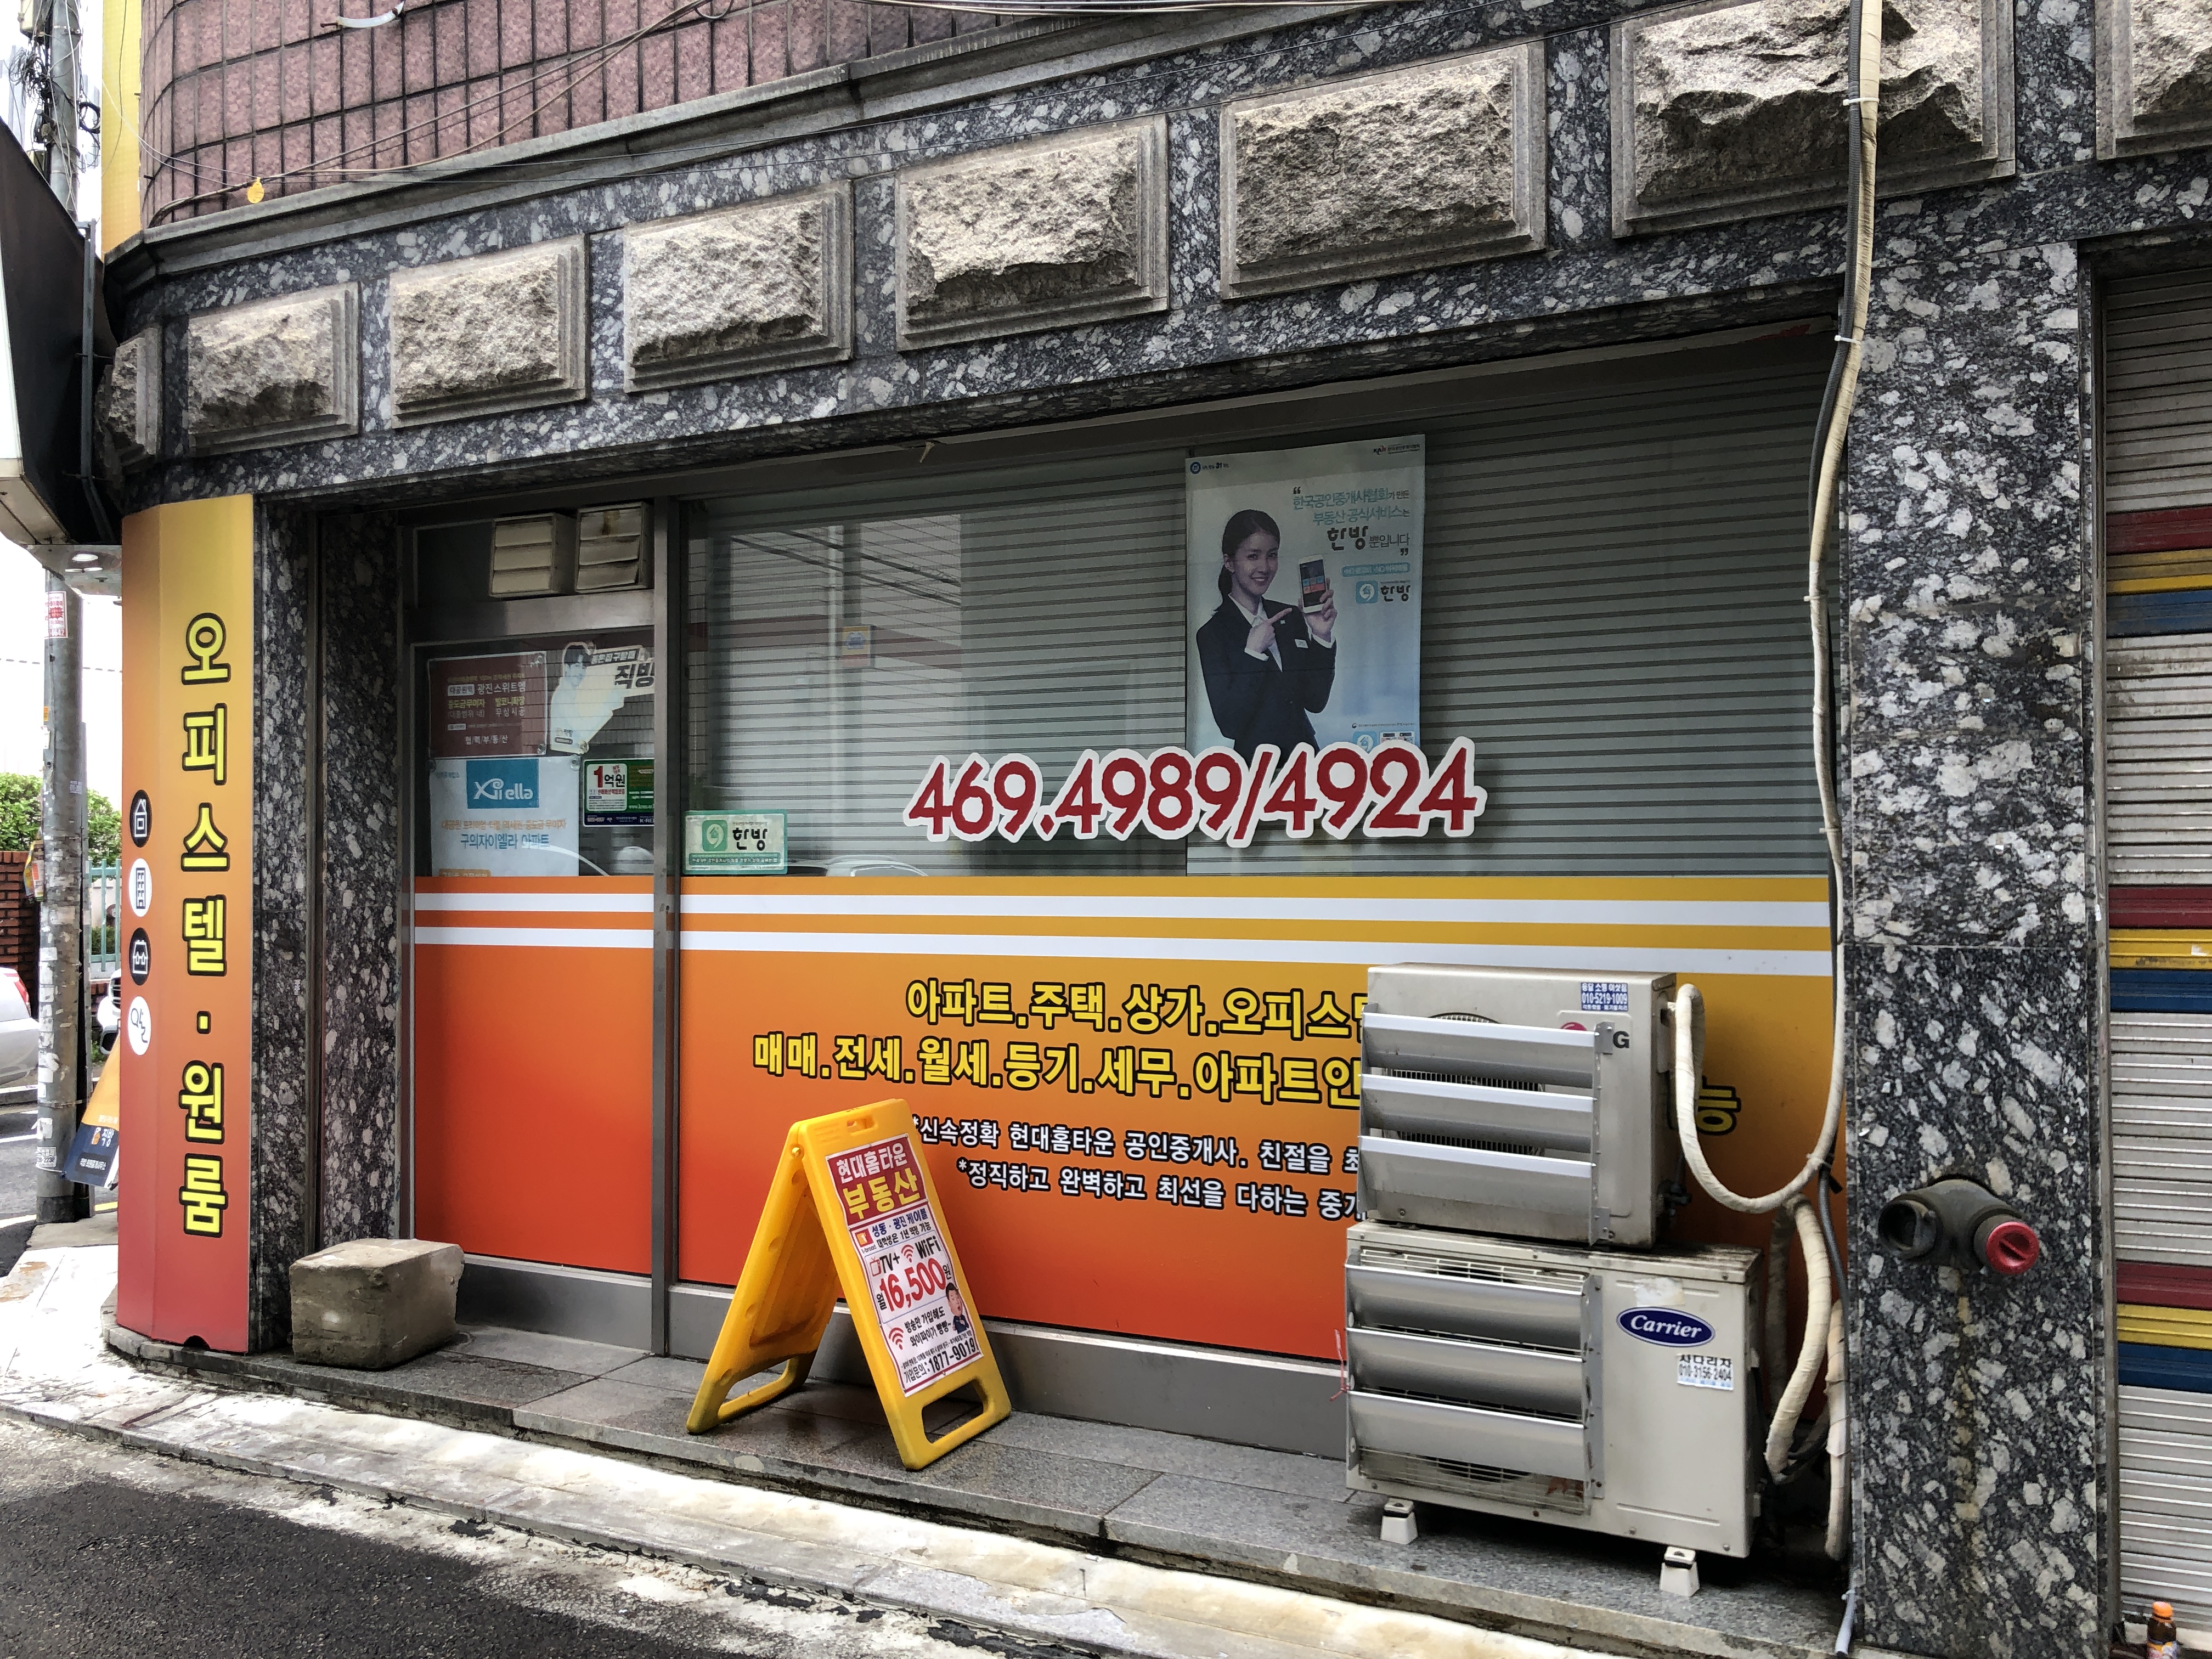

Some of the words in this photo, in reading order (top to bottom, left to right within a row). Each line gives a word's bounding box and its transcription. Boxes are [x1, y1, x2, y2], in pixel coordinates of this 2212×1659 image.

[1293, 487, 1395, 510] 한국공인중개사협회가
[1396, 490, 1409, 500] 만든
[1313, 510, 1345, 526] 부동산
[1327, 526, 1369, 551] 한방
[1369, 533, 1410, 548] 뿐입니다
[1380, 585, 1410, 602] 한방
[615, 662, 654, 689] 직방
[906, 743, 1480, 842] 469.4989/4924
[521, 833, 549, 849] 아파트
[732, 827, 768, 851] 한방
[1582, 992, 1627, 1005] 010-5219-1009
[1613, 1031, 1630, 1048] G
[1008, 1121, 1115, 1158] 현대홈타운
[1259, 1139, 1331, 1175] 친절을
[837, 1143, 907, 1184] 현대홈타운
[843, 1168, 920, 1219] 부동산
[1059, 1167, 1147, 1200] 완벽하고
[1156, 1175, 1226, 1210] 최선을
[1235, 1182, 1308, 1217] 다하는
[906, 1208, 928, 1224] 케이블
[877, 1233, 899, 1248] 대학생은
[900, 1229, 910, 1240] 1년
[909, 1226, 919, 1235] 약정
[919, 1222, 932, 1232] 가능
[915, 1235, 941, 1259] WiFi
[942, 1264, 952, 1280] 원
[879, 1258, 946, 1312] 16,500
[876, 1292, 887, 1311] 월
[922, 1306, 946, 1325] 가입해도
[1630, 1314, 1702, 1338] Carrier
[910, 1326, 938, 1347] 와이파이가
